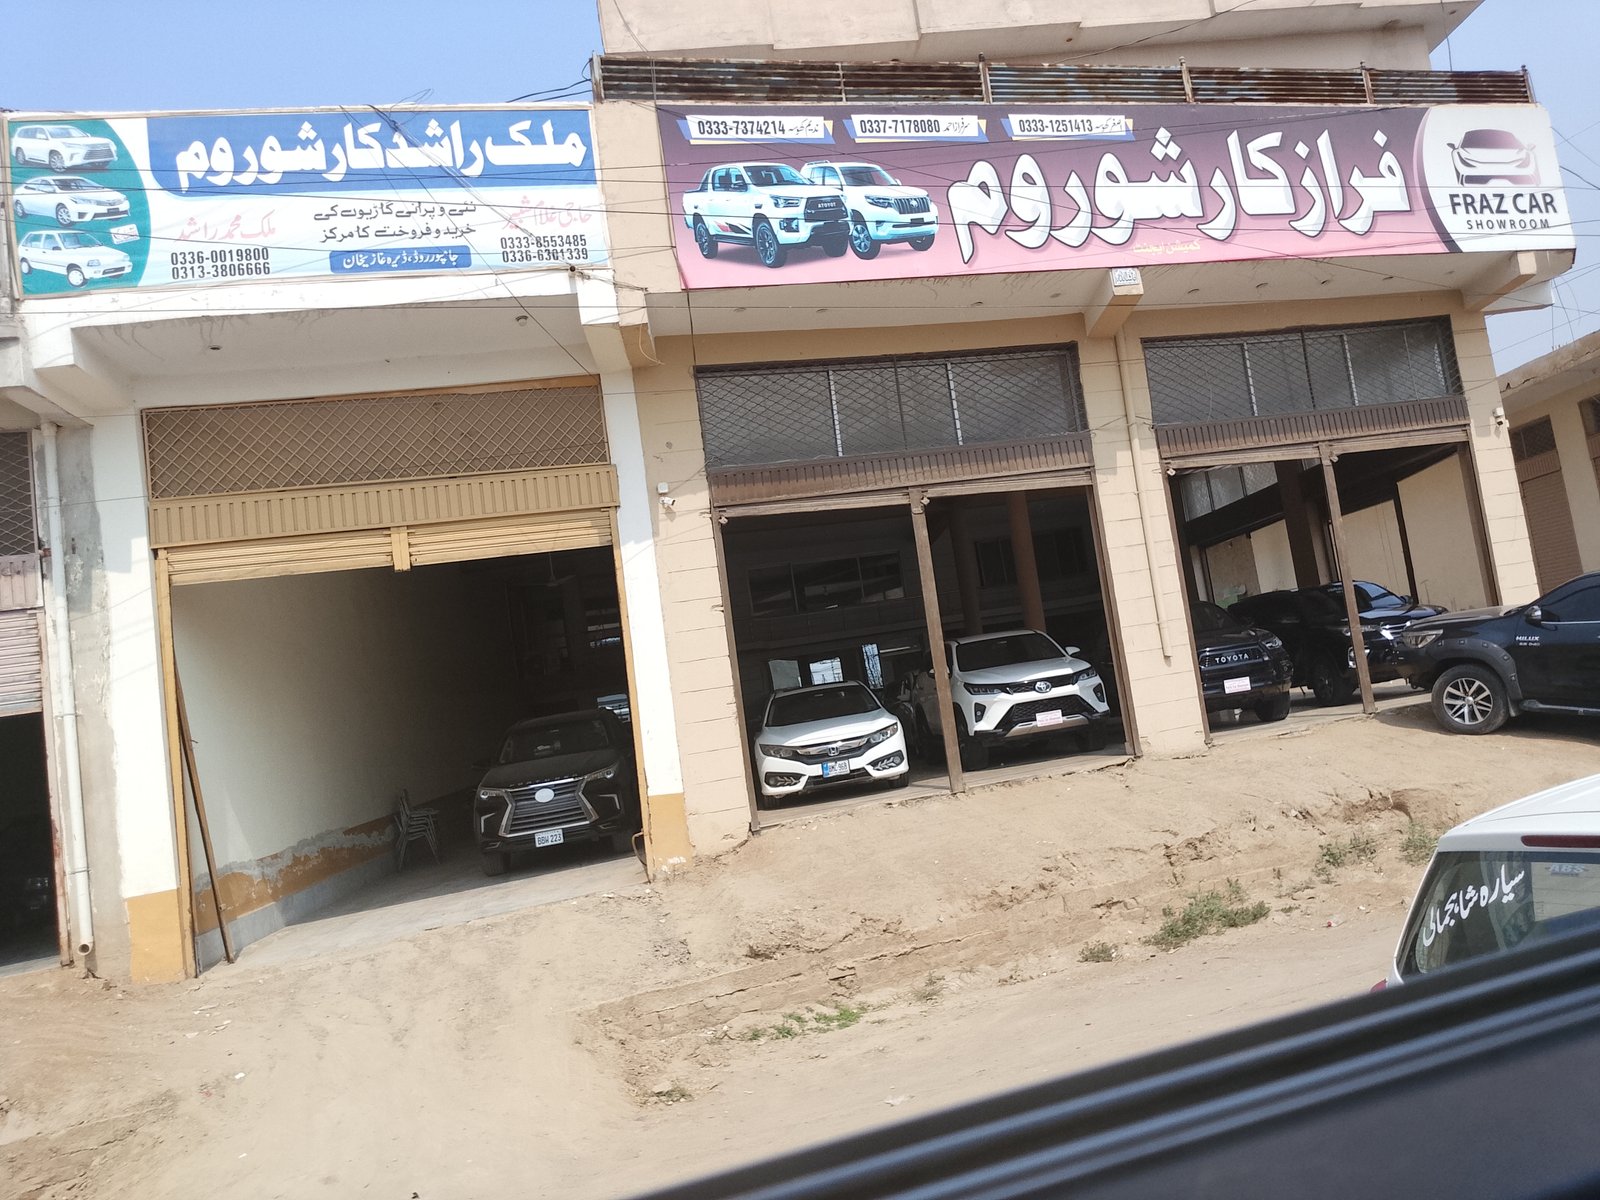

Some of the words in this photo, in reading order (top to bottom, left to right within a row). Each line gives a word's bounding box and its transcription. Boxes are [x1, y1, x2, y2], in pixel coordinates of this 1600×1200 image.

[697, 120, 786, 135] 0333-7374214
[860, 119, 940, 134] 0337-7178080
[1018, 118, 1093, 133] 0333-1251413
[321, 119, 387, 182] کار
[386, 118, 485, 178] راشد
[485, 118, 588, 167] ملک
[1196, 128, 1297, 241] کار
[1288, 128, 1412, 238] فراز
[1449, 193, 1508, 215] FRAZ
[1512, 192, 1558, 214] CAR
[356, 225, 370, 238] کا
[1466, 218, 1550, 230] SHOWROOM
[320, 226, 354, 243] مرکز
[170, 247, 269, 266] 0336-0019800
[171, 262, 270, 280] 0313-3806666
[1215, 653, 1249, 663] TOYOTA
[550, 833, 562, 843] 223
[1479, 864, 1525, 907] سیارہ
